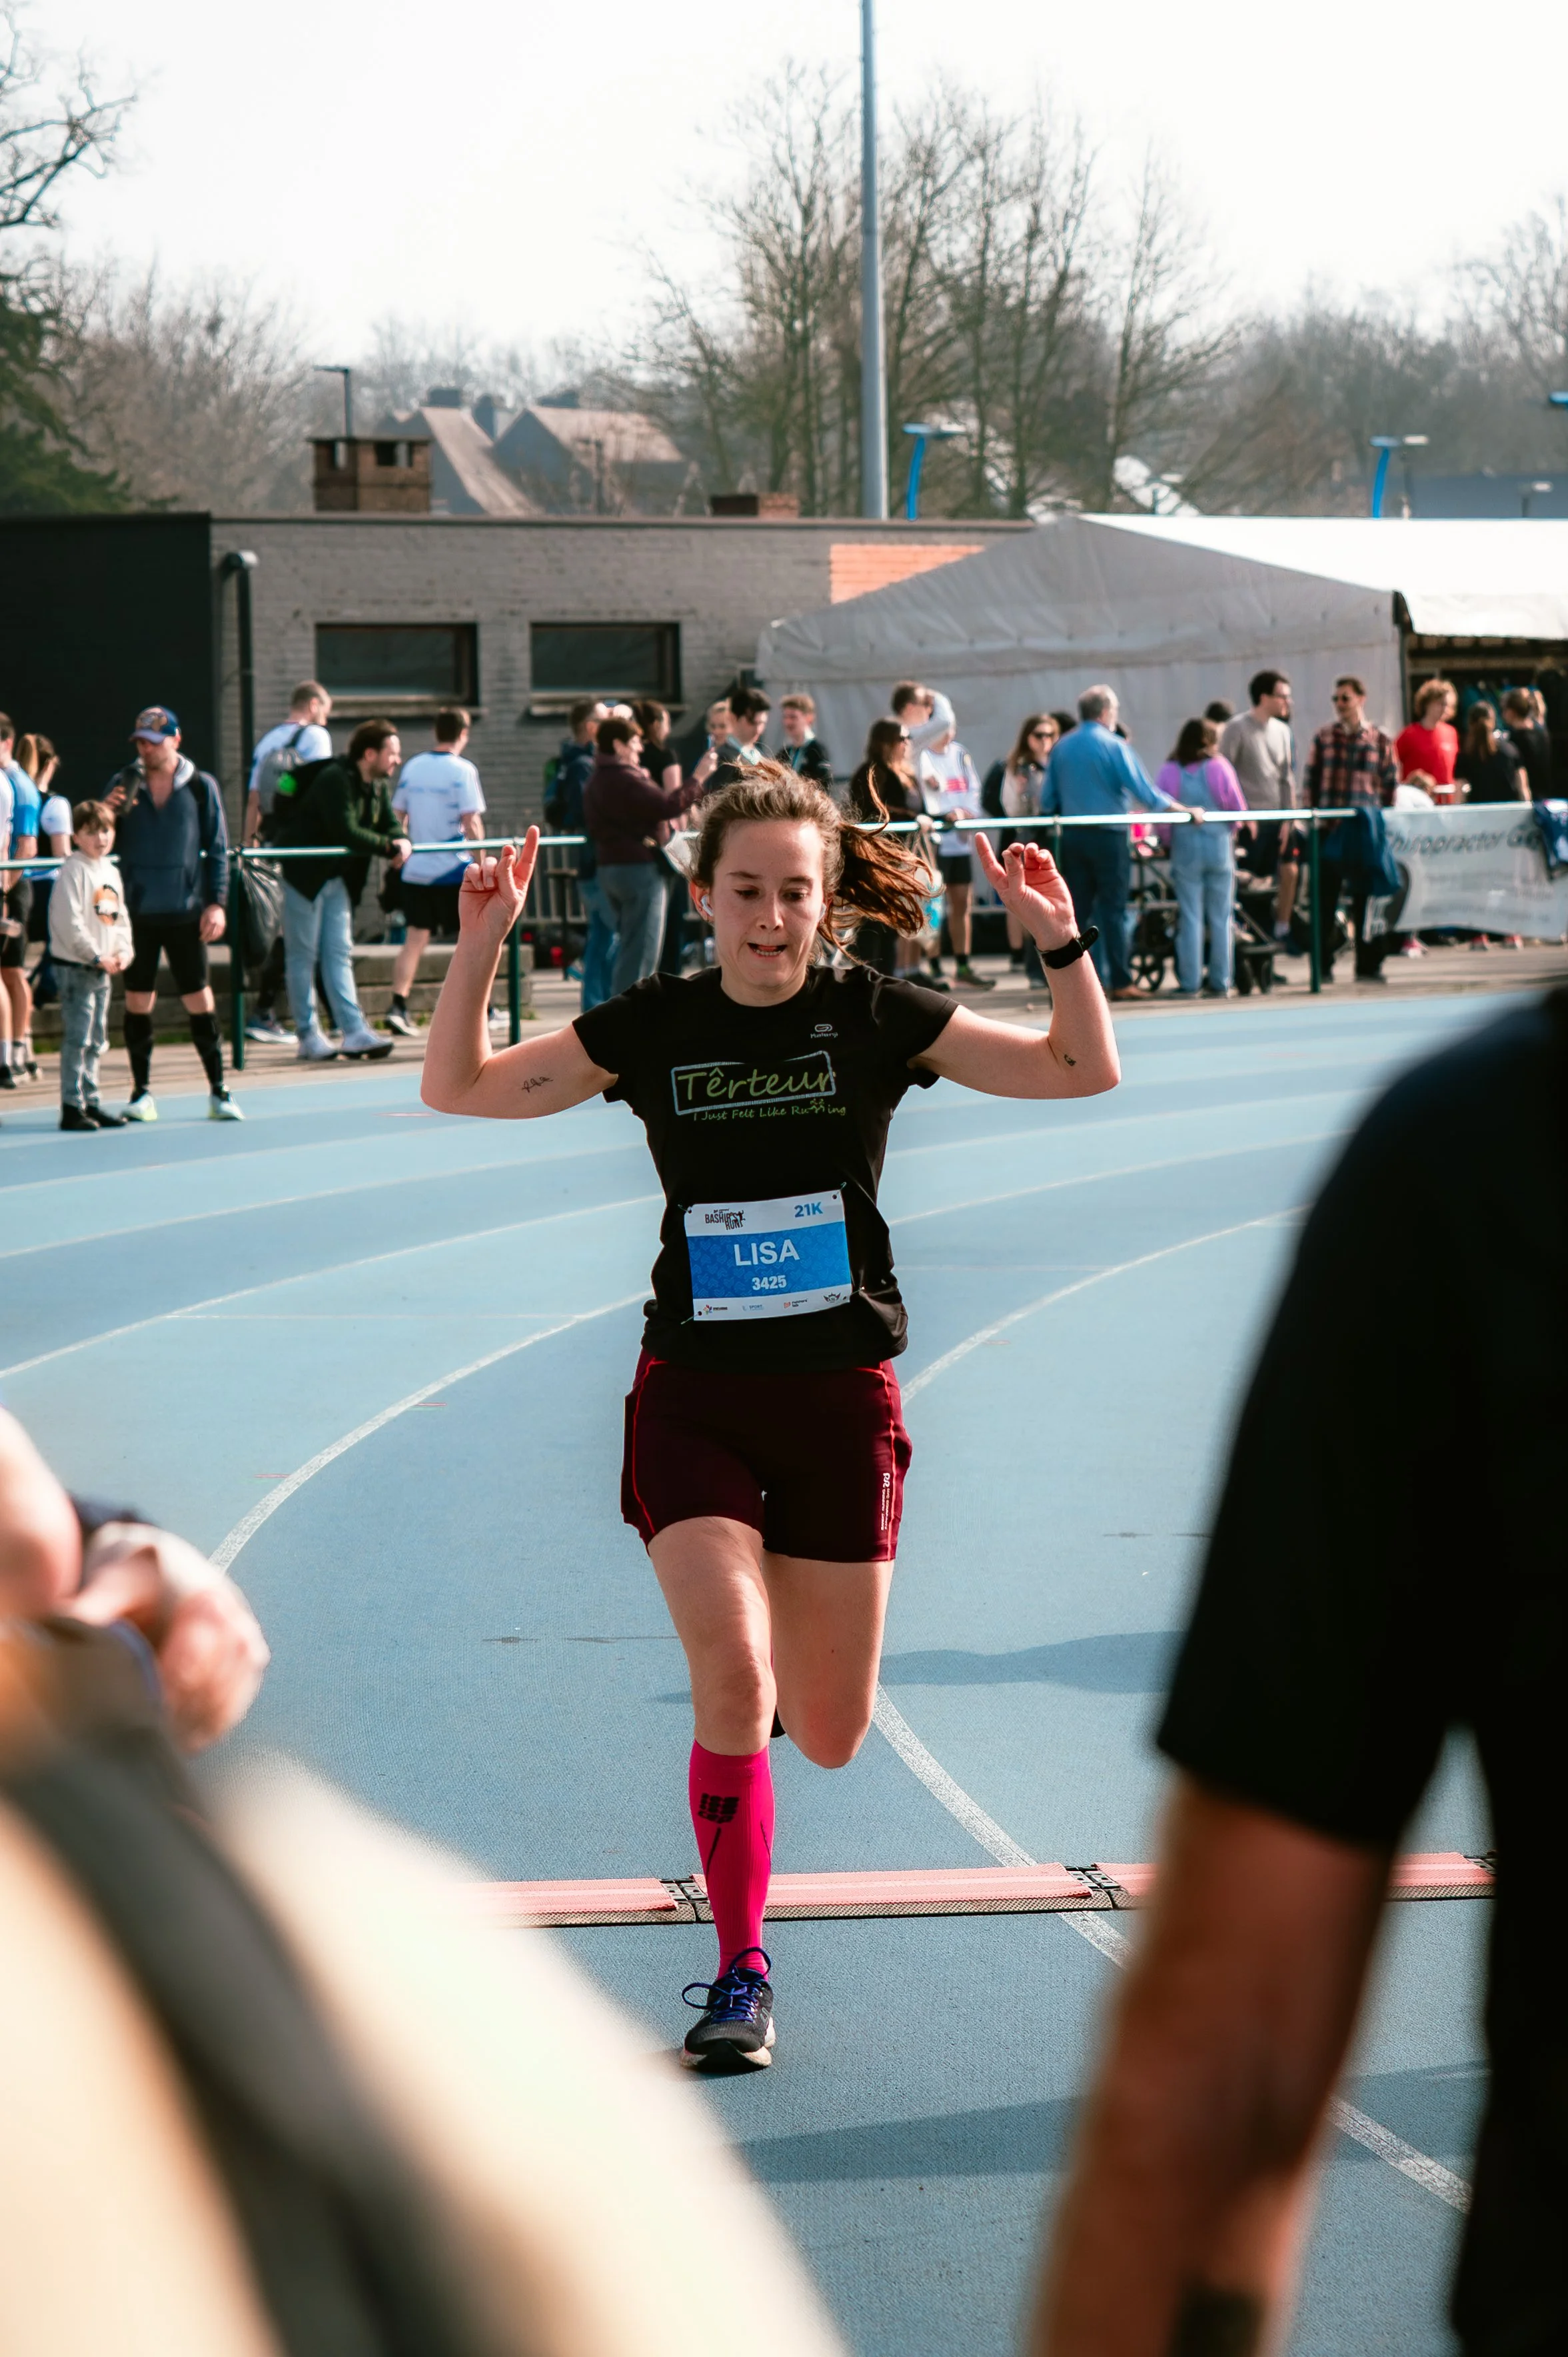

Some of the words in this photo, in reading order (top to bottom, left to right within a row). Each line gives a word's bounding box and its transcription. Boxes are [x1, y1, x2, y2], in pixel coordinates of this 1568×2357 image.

[701, 1109, 728, 1121] Just
[732, 1107, 755, 1119] Felt
[760, 1105, 787, 1118] Like
[794, 1202, 823, 1218] 21K
[734, 1239, 800, 1266] LISA
[752, 1274, 787, 1290] 3425
